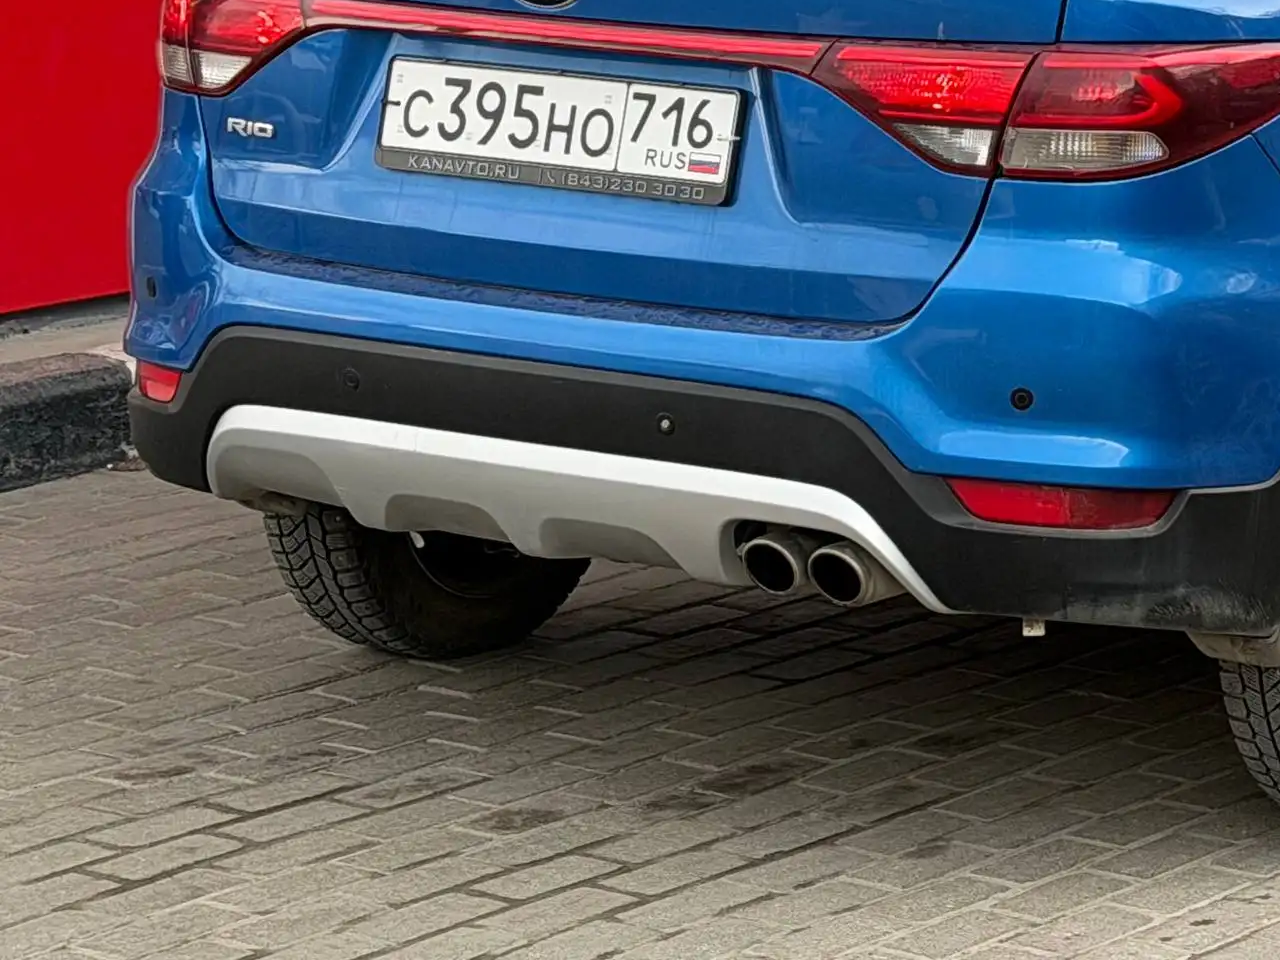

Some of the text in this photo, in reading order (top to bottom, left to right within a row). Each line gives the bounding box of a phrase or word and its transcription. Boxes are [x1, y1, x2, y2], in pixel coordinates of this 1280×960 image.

[227, 116, 274, 138] RIO
[630, 92, 714, 149] 716
[408, 154, 520, 179] KANAVTO.RU
[645, 148, 687, 170] RUS
